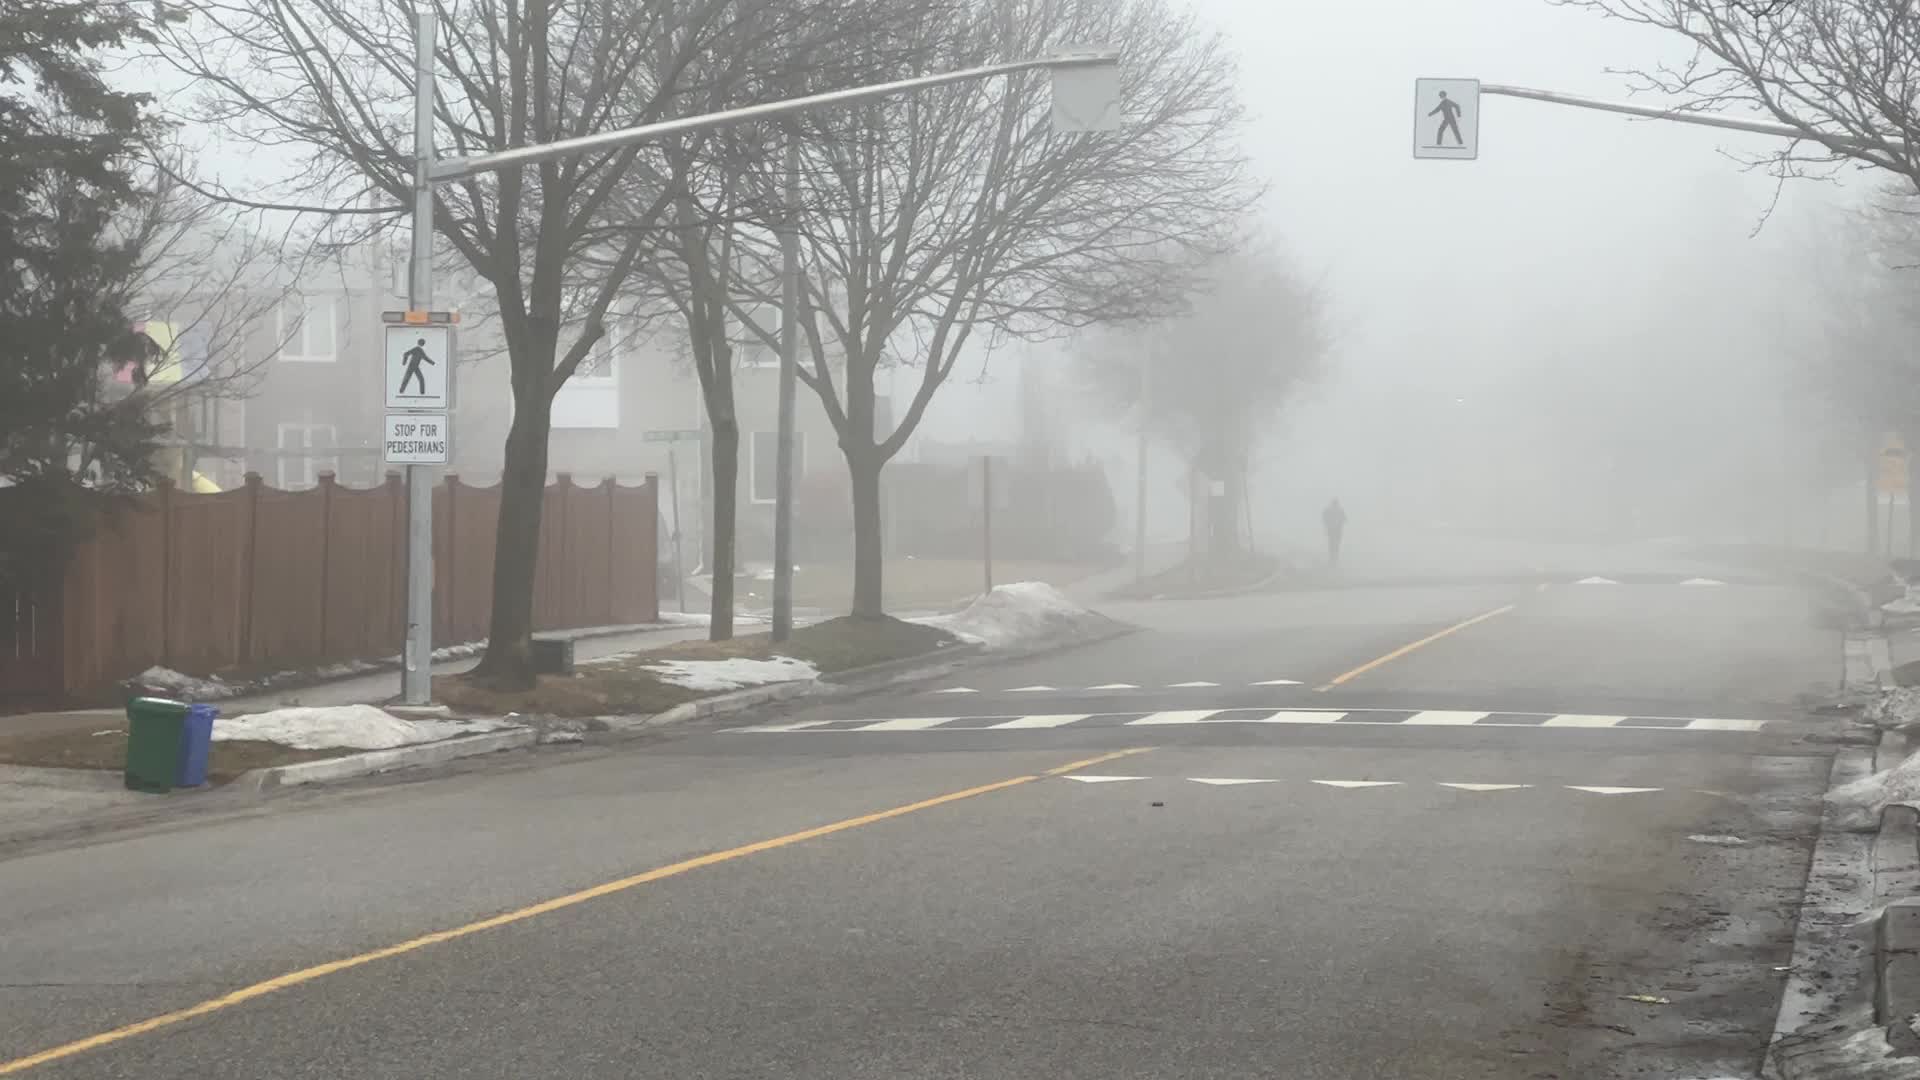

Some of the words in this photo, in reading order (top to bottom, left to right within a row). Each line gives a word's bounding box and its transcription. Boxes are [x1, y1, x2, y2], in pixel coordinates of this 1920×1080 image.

[394, 424, 416, 437] STOP
[420, 424, 437, 437] FOR
[386, 441, 445, 454] PEDESTRIANS
